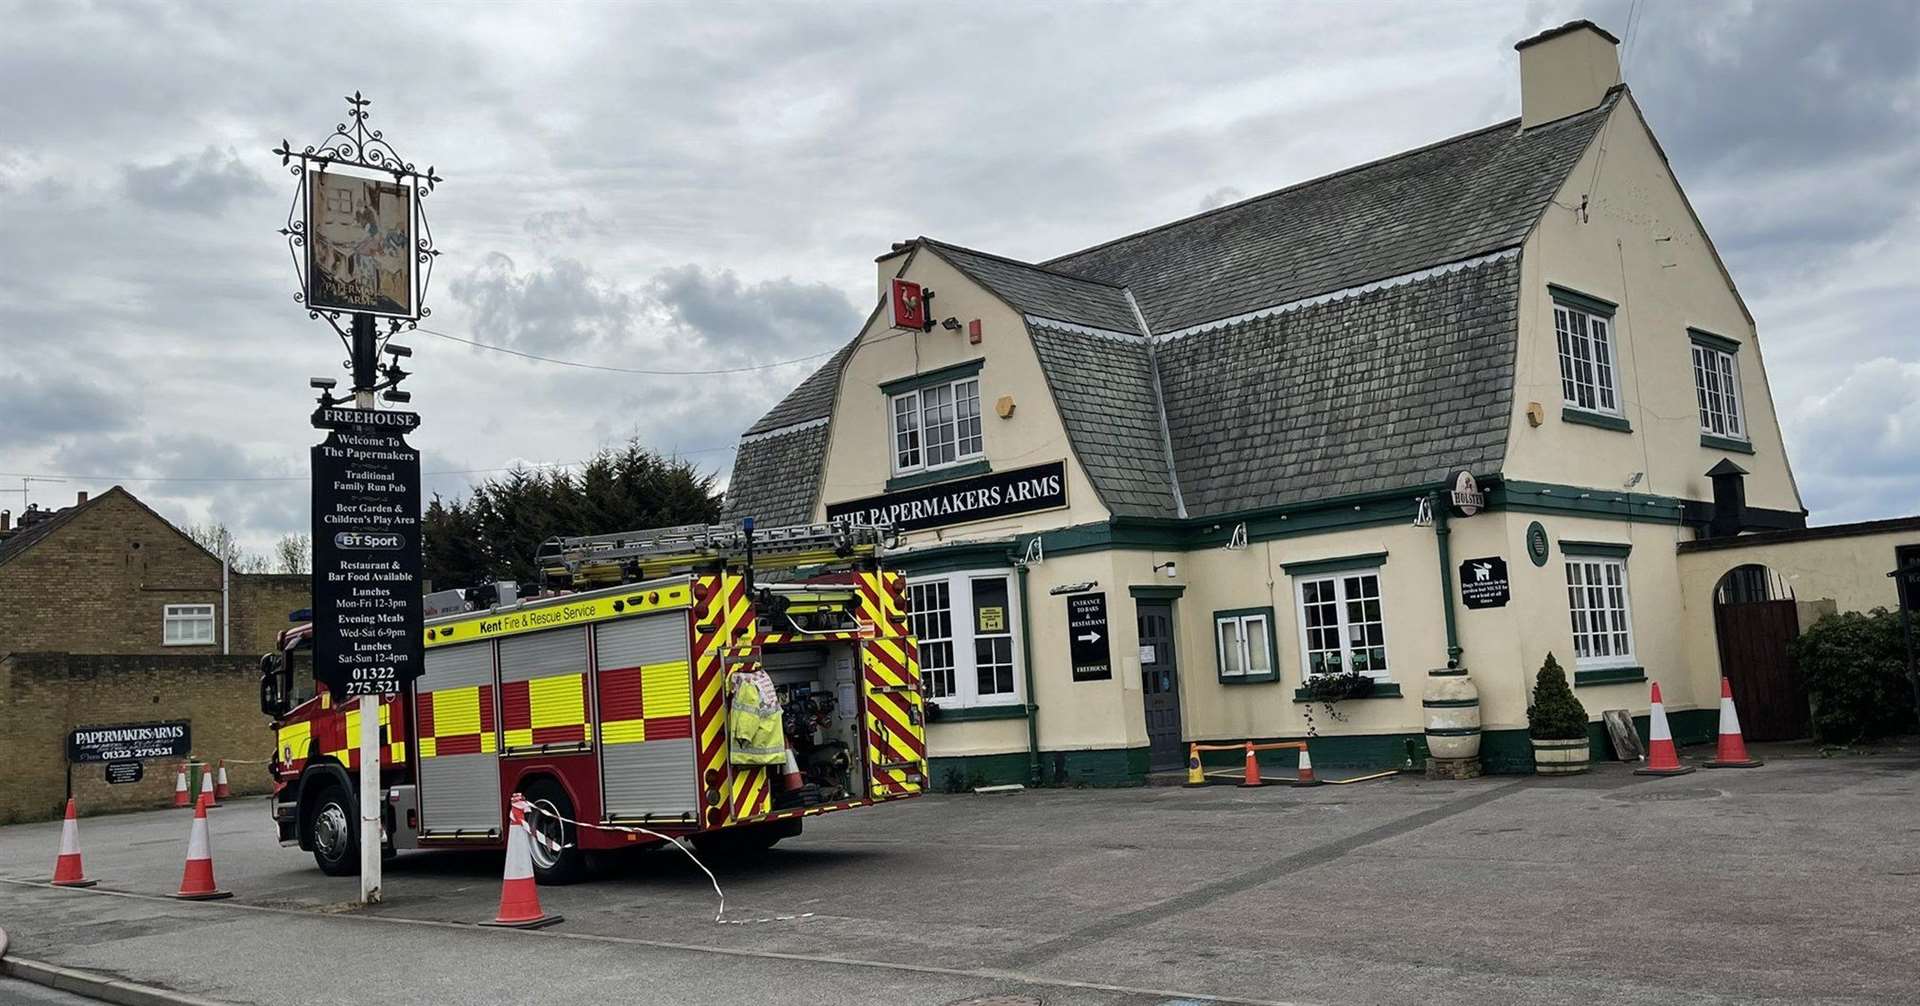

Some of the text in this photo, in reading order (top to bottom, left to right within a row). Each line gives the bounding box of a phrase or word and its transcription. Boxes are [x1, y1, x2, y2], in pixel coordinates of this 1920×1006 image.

[324, 409, 415, 426] FREEHOUSE
[337, 434, 400, 447] Welcome To
[323, 446, 415, 461] The Papermakers
[345, 470, 395, 481] Traditional
[334, 481, 407, 493] Family Run Pub
[832, 475, 1060, 527] THE PAPERMAKERS ARMS
[336, 503, 403, 513] Beer Garden &
[324, 514, 415, 526] Children's Play Area
[343, 535, 398, 548] BT Sport
[340, 561, 401, 570] Restaurant &
[328, 572, 413, 581] Bar Food Available
[352, 587, 390, 596] Lunches
[336, 599, 407, 609] Mon-Fri 12-3pm
[1073, 599, 1100, 607] ENTRANCE
[338, 613, 404, 624] Evening Meals
[480, 606, 596, 634] Kent Fire & Rescue Service
[1072, 619, 1105, 627] RESTAURANT
[339, 628, 406, 638] Wed-Sat 6-9pm
[354, 642, 392, 651] Lunches
[338, 653, 408, 664] Sat-Sun 12-4pm
[352, 667, 395, 680] 01322
[1076, 665, 1108, 673] FREEHOUSE
[346, 680, 400, 694] 275 521
[76, 726, 184, 745] PAPERMAKERS ARMS
